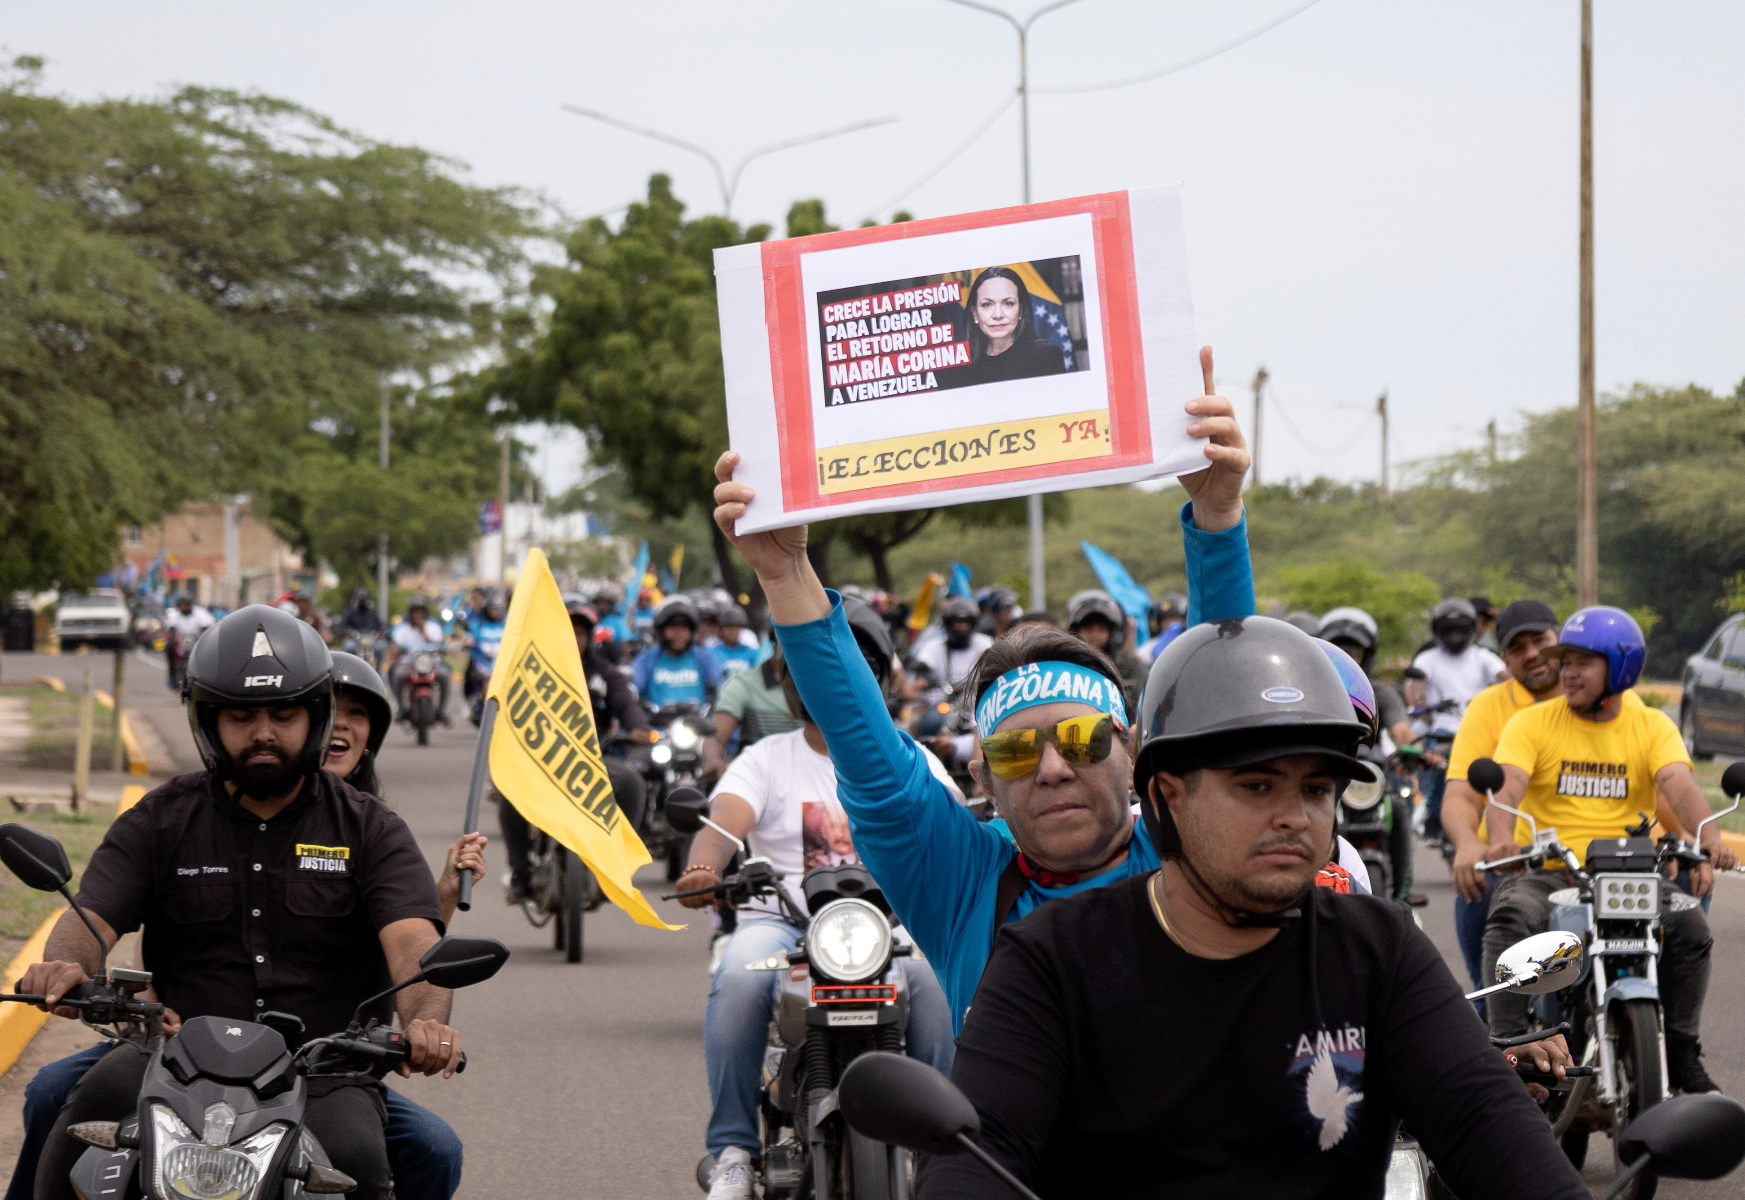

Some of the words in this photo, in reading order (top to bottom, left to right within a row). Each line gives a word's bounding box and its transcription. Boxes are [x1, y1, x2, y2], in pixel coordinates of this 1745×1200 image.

[824, 299, 871, 323] CRECE
[872, 295, 892, 315] LA
[894, 282, 960, 310] PRESIÓN
[825, 319, 869, 342] PARA
[871, 308, 933, 334] LOGRAR
[827, 342, 847, 362] EL
[849, 329, 928, 358] RETORNO
[931, 324, 953, 344] DE
[829, 355, 895, 386] MARÍA
[897, 343, 969, 374] CORINA
[831, 388, 844, 405] A
[846, 371, 938, 402] VENEZUELA
[818, 429, 1036, 485] ¡ELECCIONES
[1017, 662, 1040, 676] LA
[978, 671, 1103, 739] VENEZOLANA
[1561, 761, 1627, 775] PRIMERO
[1558, 773, 1627, 798] JUSTICIA
[299, 857, 346, 872] JUSTICIA
[301, 847, 345, 858] PRIMERO
[177, 868, 199, 877] Diego
[202, 866, 228, 874] Torres
